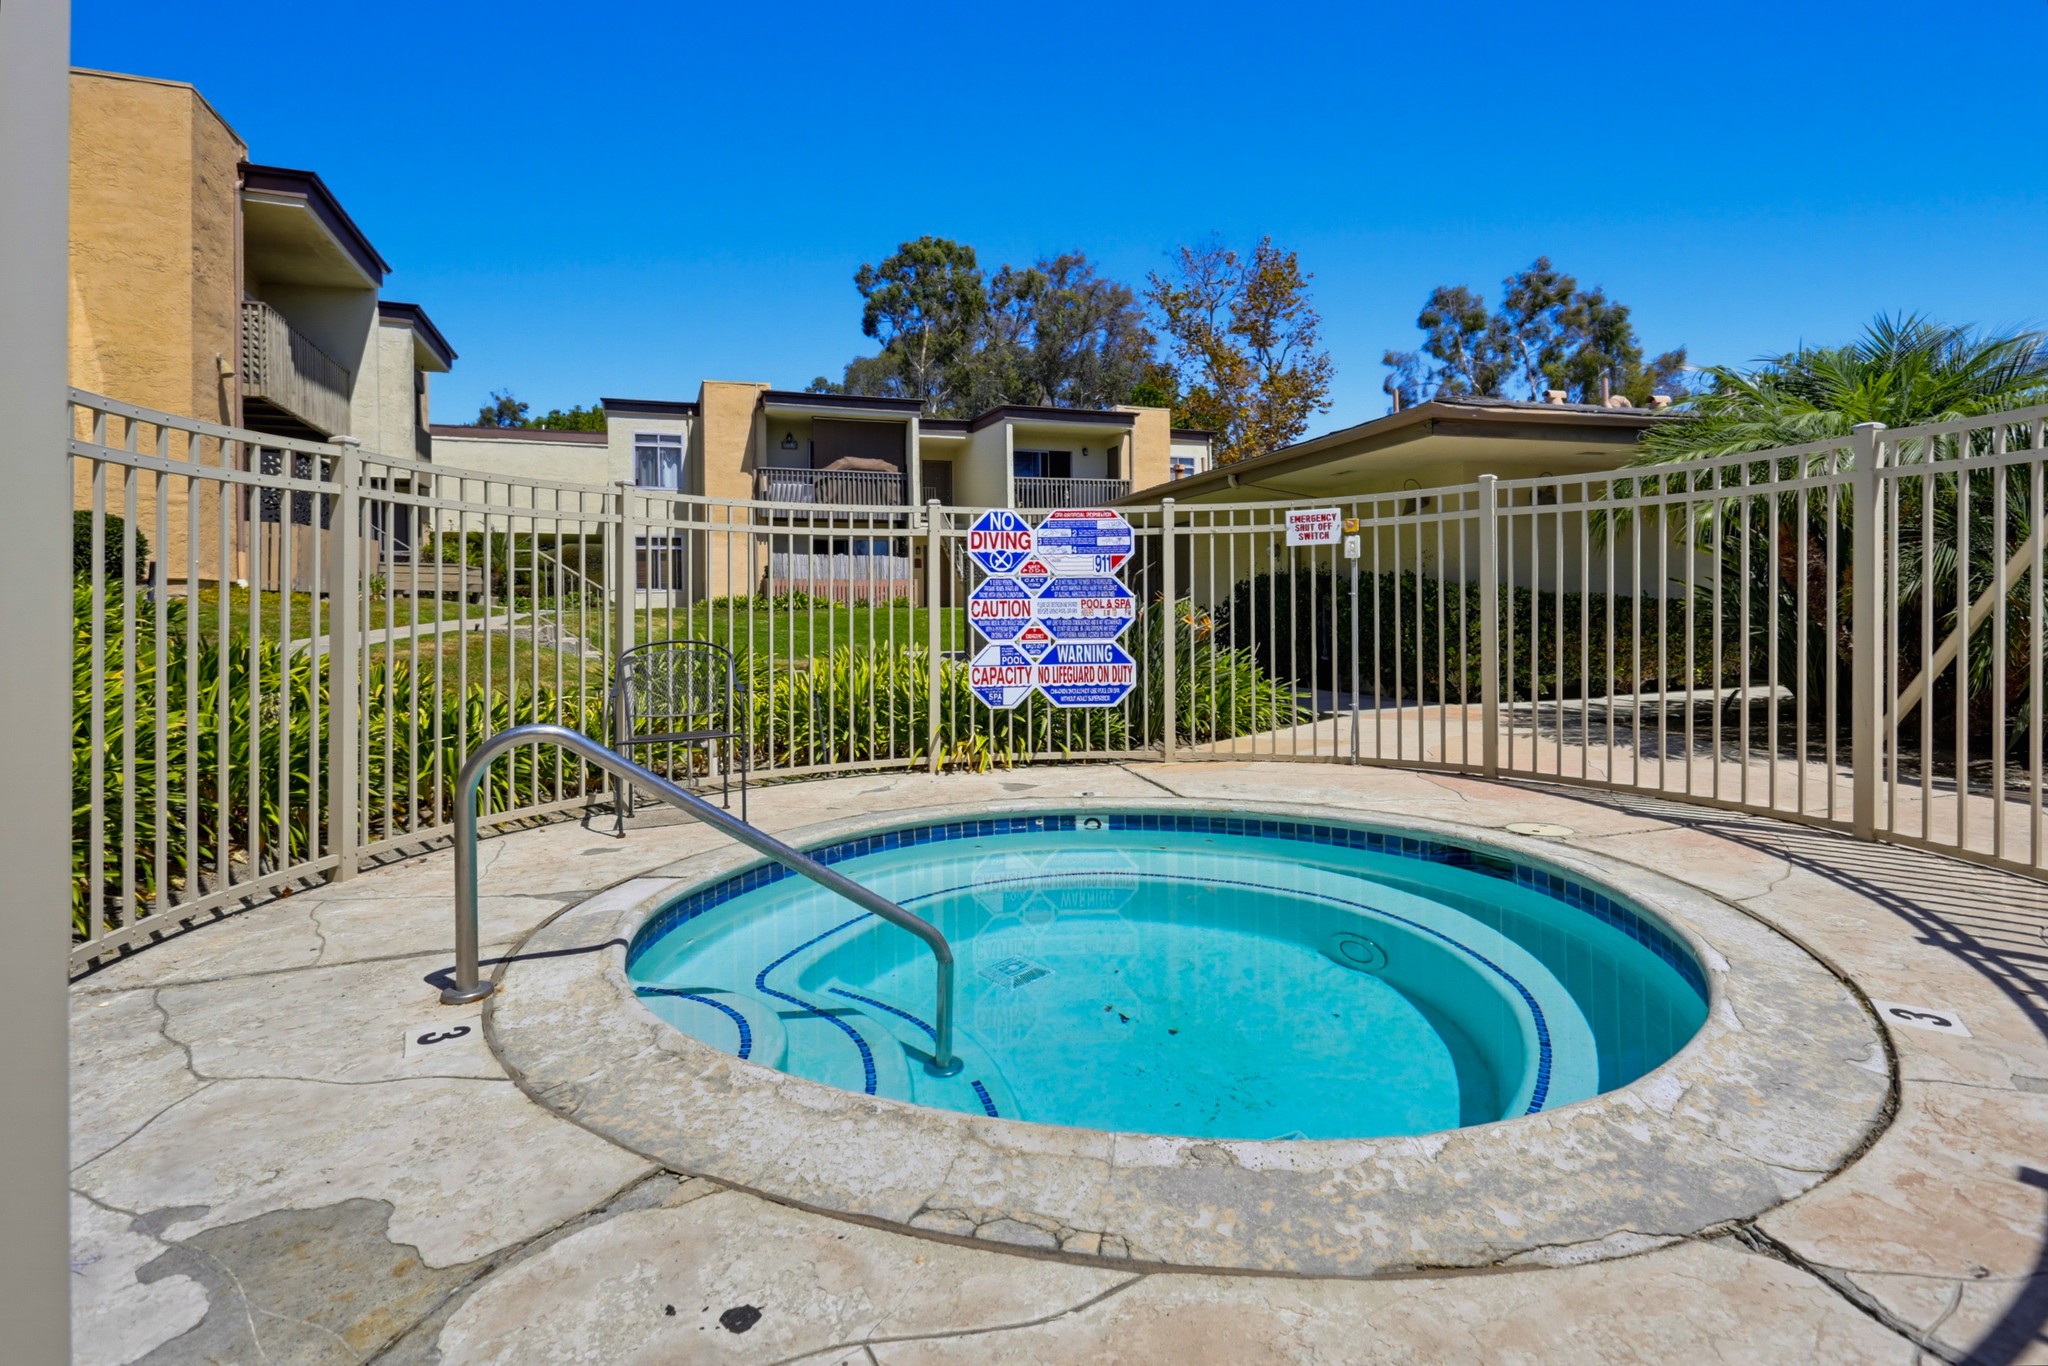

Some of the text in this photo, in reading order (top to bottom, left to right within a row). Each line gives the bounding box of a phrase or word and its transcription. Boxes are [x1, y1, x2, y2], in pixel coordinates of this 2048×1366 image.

[990, 512, 1015, 530] NO
[1290, 513, 1337, 523] EMERGENCY
[1295, 523, 1332, 532] SHUT OFF
[1298, 531, 1329, 540] SWITCH
[971, 531, 1031, 550] DIVING
[1095, 555, 1111, 572] 911
[971, 600, 1031, 617] CAUTION
[1081, 599, 1105, 609] POOL
[1106, 600, 1112, 608] &
[1114, 599, 1131, 609] SPA
[1002, 656, 1024, 665] POOL
[1056, 644, 1113, 663] WARNING
[972, 666, 1032, 685] CAPACITY
[1038, 665, 1133, 683] NO LIFEGUARD ON DUTY
[1889, 1008, 1952, 1027] 3
[417, 1026, 471, 1045] 3
